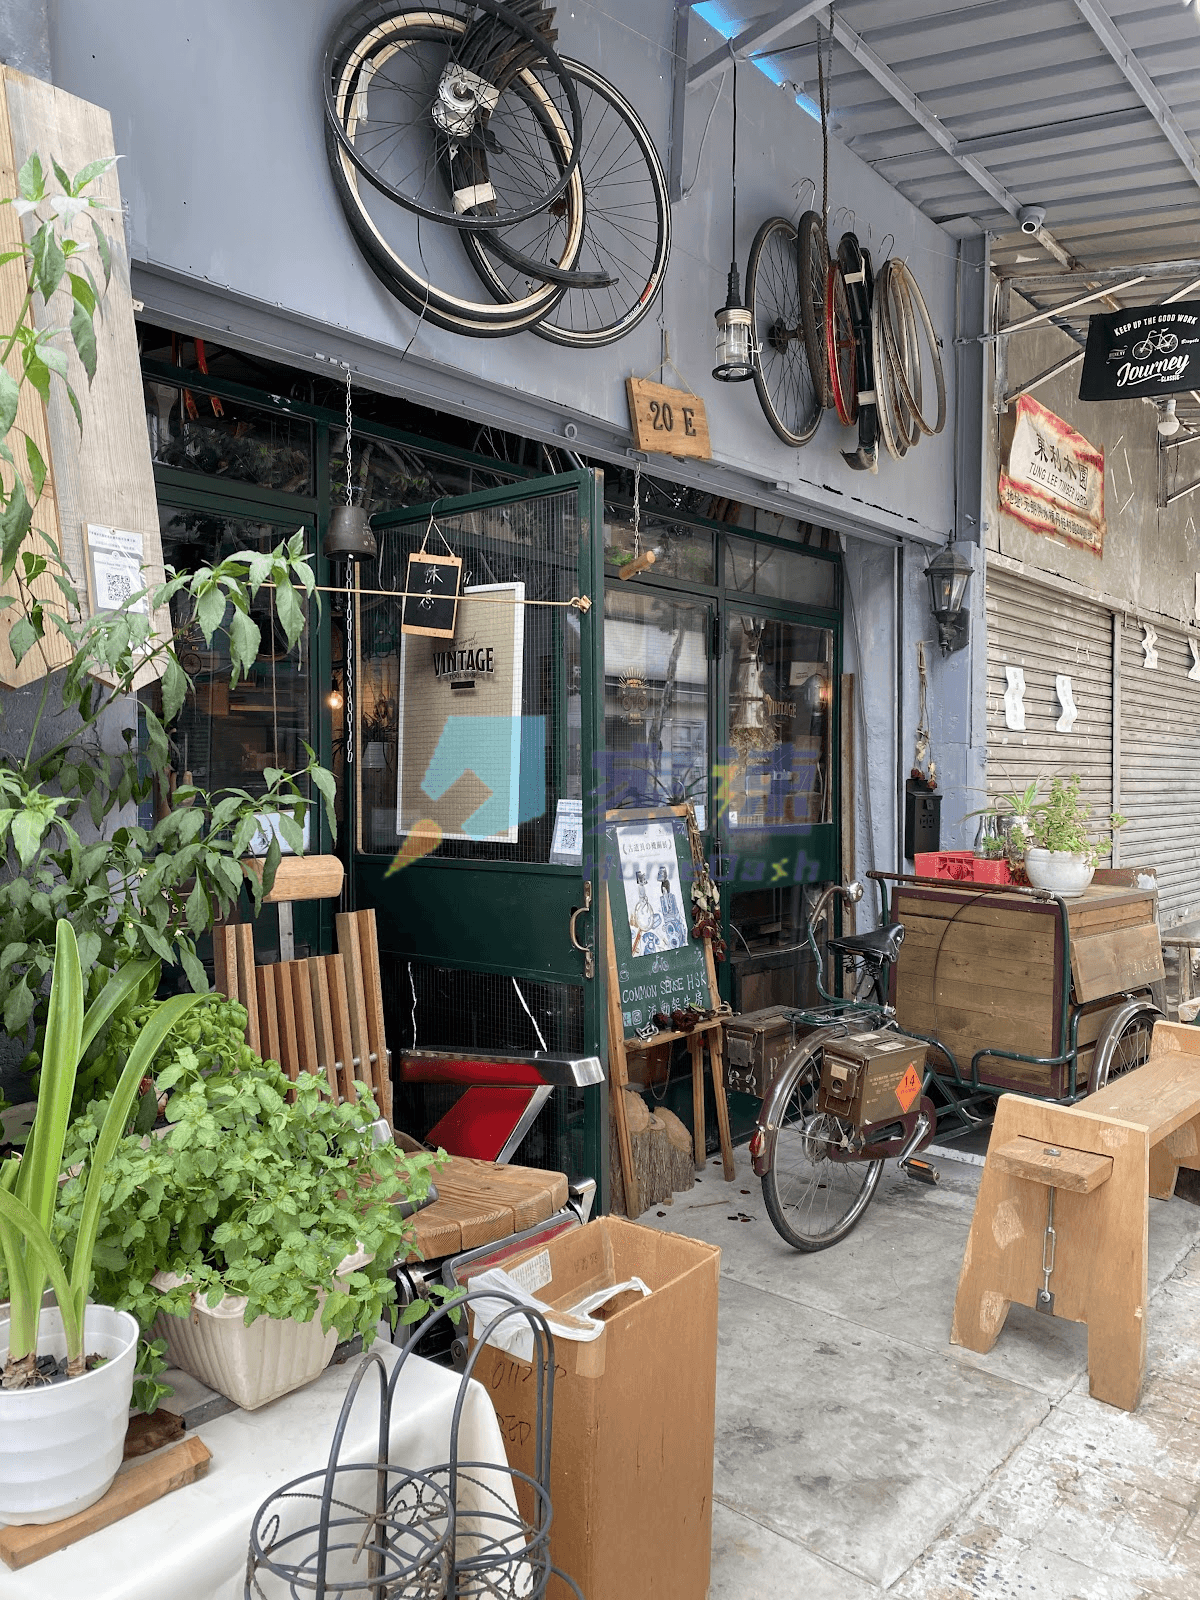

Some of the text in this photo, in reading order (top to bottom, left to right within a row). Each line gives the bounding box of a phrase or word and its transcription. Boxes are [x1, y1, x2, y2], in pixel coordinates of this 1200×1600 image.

[1113, 314, 1198, 337] KEEP UP THE GOOD WORK
[1116, 354, 1190, 387] Journey
[649, 401, 697, 437] 20 E
[1029, 461, 1046, 481] TUNG
[1046, 472, 1058, 487] LEE
[1059, 479, 1075, 499] TIMBER
[432, 647, 494, 678] VINTAGE
[767, 698, 797, 719] VINTAGE
[622, 969, 707, 1004] COMMON SENSE HSK
